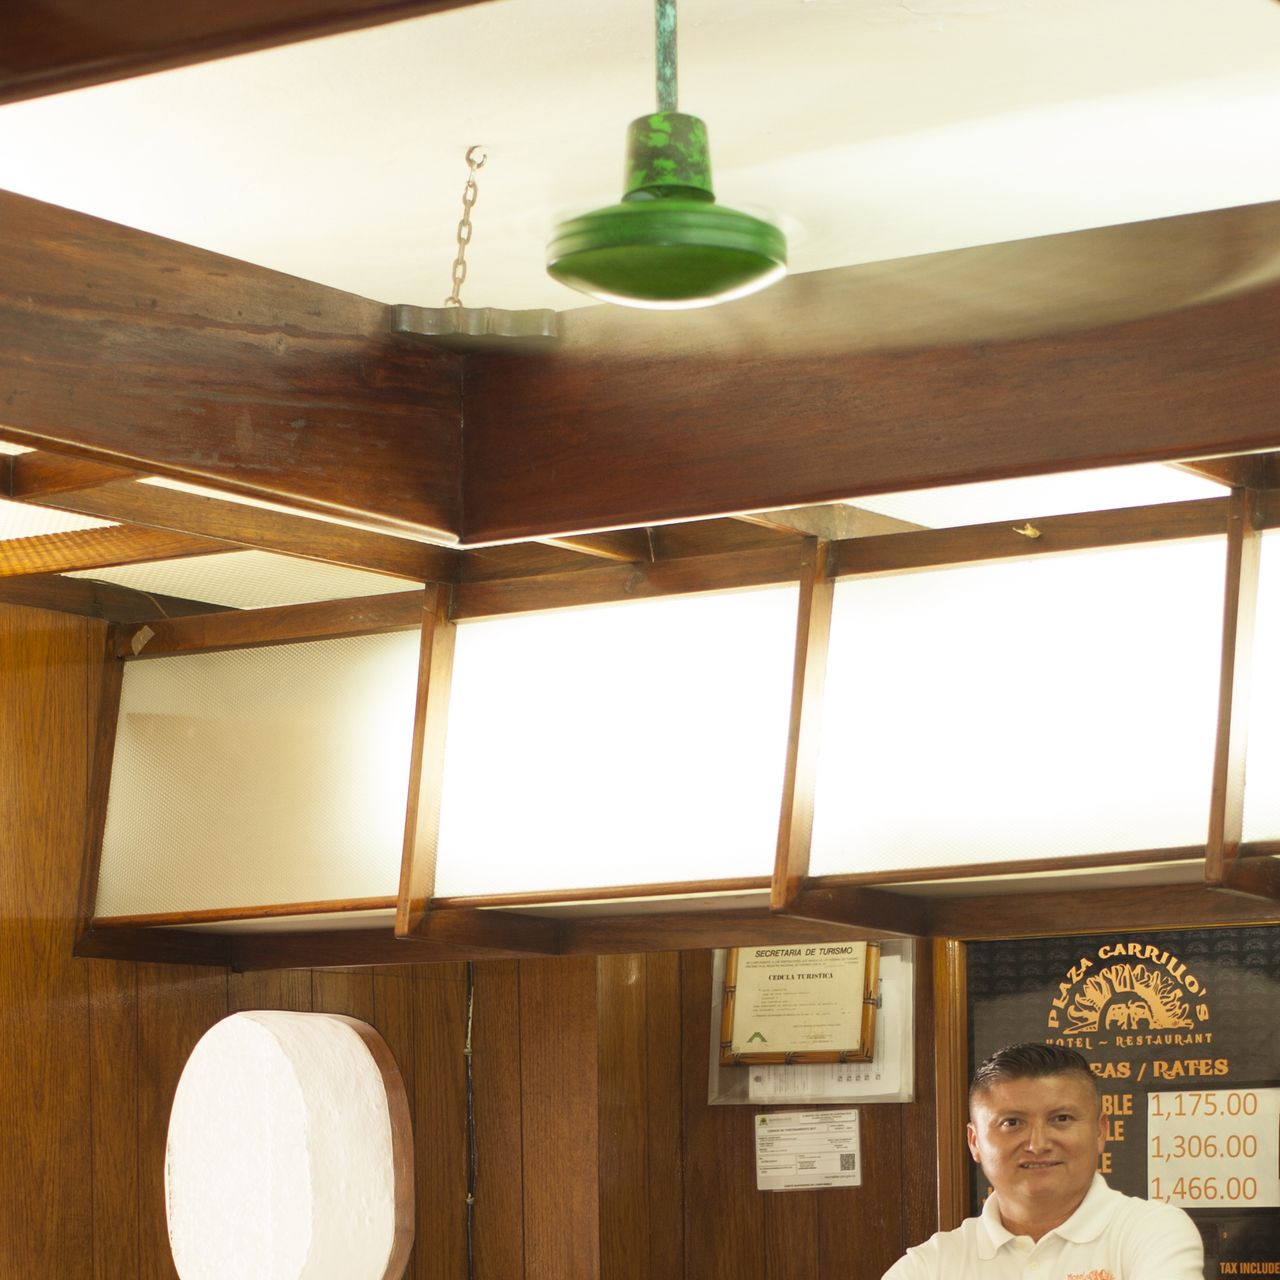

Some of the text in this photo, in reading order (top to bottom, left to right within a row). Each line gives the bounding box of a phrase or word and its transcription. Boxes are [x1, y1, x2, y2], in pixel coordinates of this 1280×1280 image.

[755, 949, 802, 958] SECRETARIA
[819, 947, 853, 956] TURISMO
[1047, 942, 1210, 1028] PLAZA CARRILLO'S
[1116, 1033, 1212, 1048] RESTAURANT
[1153, 1058, 1229, 1080] RATES
[1151, 1093, 1257, 1120] 1,175.00
[1151, 1135, 1257, 1162] 1,306.00
[1151, 1176, 1257, 1204] 1,466.00
[1220, 1262, 1237, 1274] TAX
